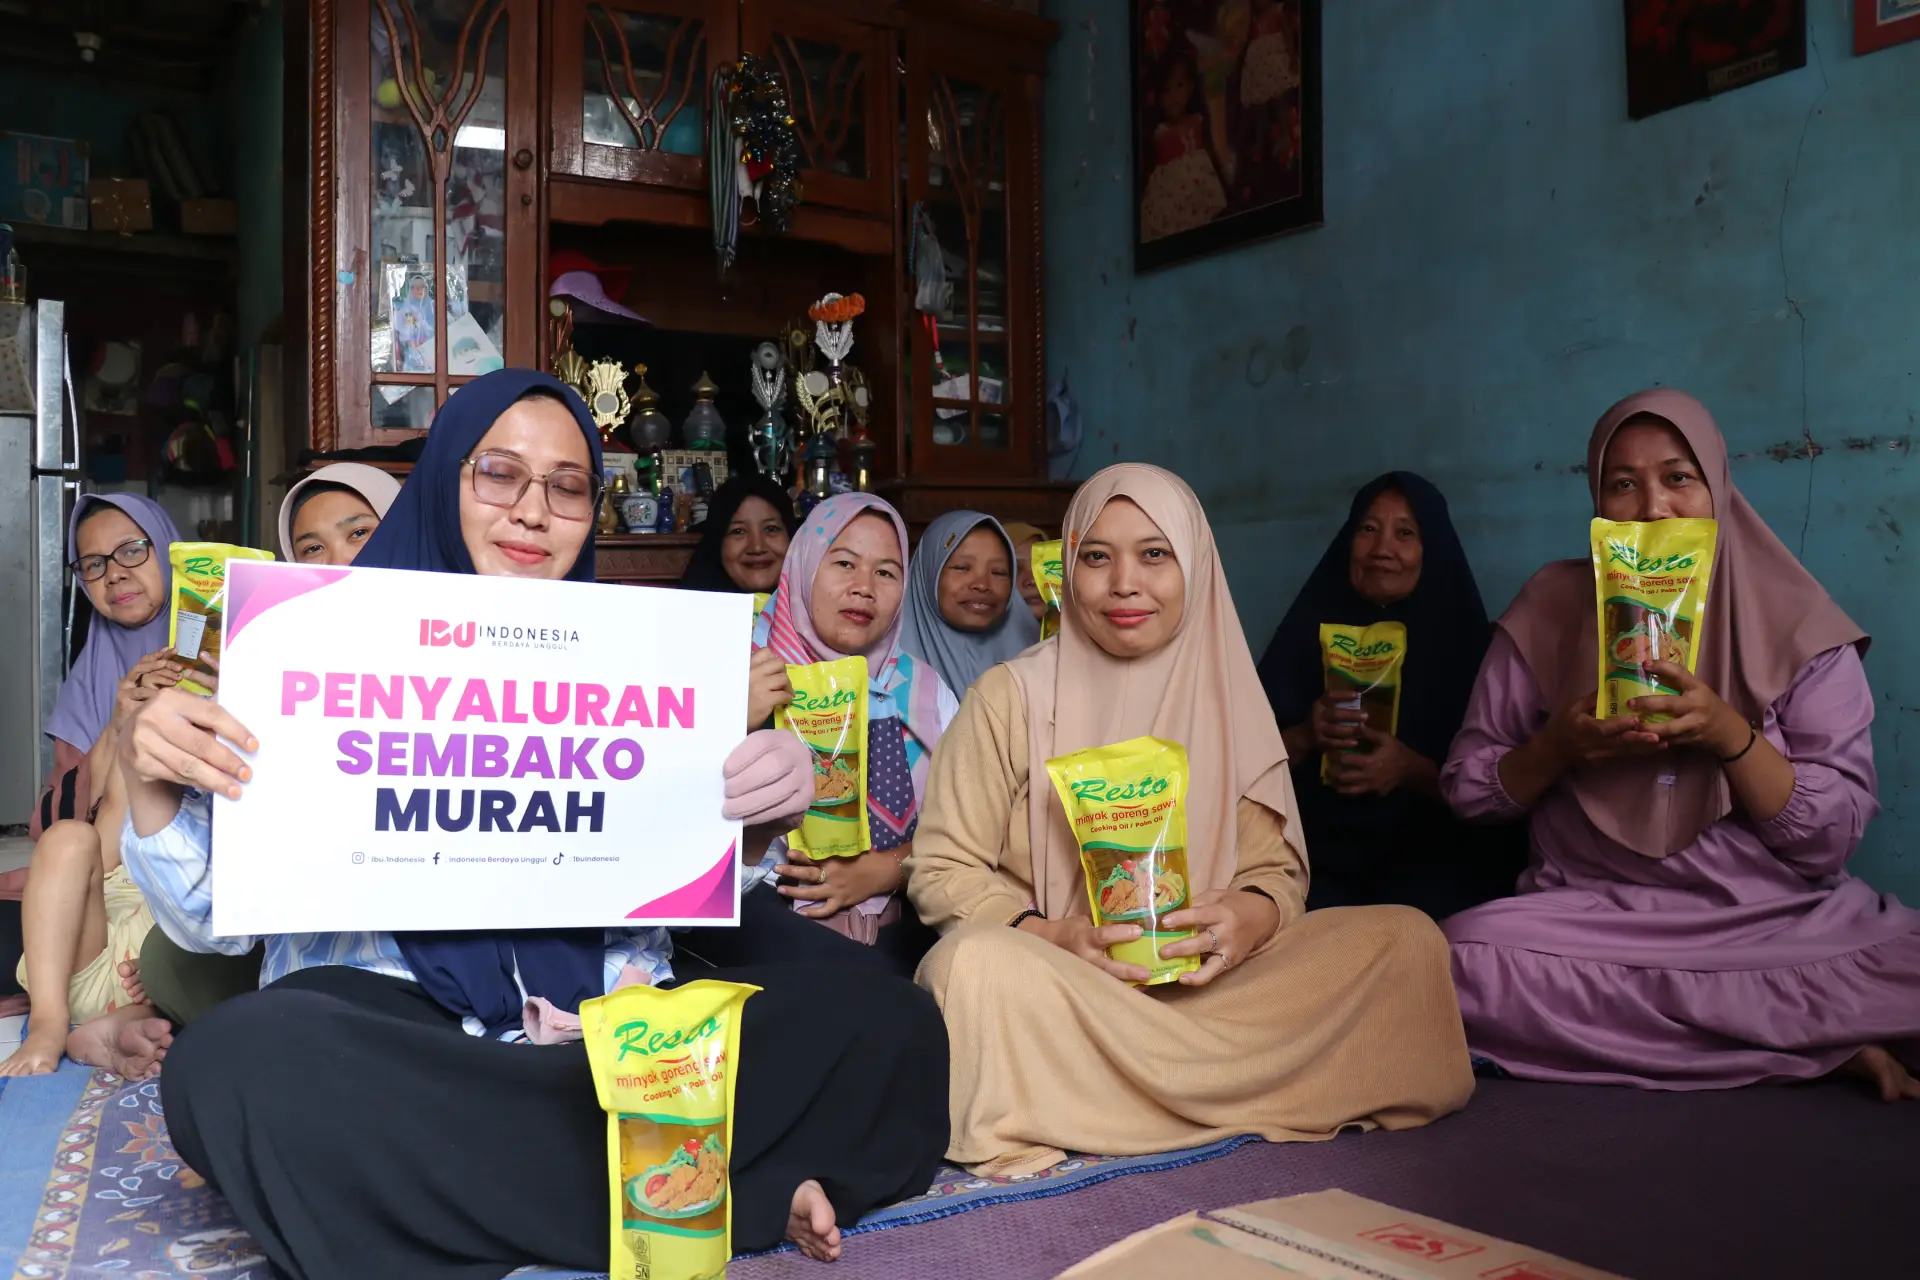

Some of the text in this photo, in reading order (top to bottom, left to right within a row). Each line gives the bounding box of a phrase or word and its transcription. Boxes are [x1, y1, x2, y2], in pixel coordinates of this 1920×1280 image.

[1609, 545, 1696, 572] Resto
[1640, 577, 1674, 588] goreng
[420, 619, 580, 648] IBU INDONESIA
[492, 640, 531, 649] BERDAYA
[1330, 633, 1394, 657] Resto
[281, 670, 695, 729] PENYALURAN
[792, 689, 857, 711] Resto
[812, 715, 841, 728] goreng
[336, 730, 645, 780] SEMBAKO
[1071, 776, 1169, 805] Resto
[374, 788, 606, 833] MURAH
[1076, 811, 1108, 826] minyak
[1112, 808, 1149, 822] goreng
[1090, 824, 1118, 833] Cooking
[1119, 822, 1129, 830] Oil
[1135, 819, 1153, 828] Palm
[1154, 815, 1163, 823] Oil
[487, 856, 520, 864] Berdaya
[520, 856, 548, 865] Unggul
[616, 1070, 658, 1089] minyak
[661, 1061, 701, 1084] goreng
[643, 1089, 672, 1102] Cooking
[711, 1071, 723, 1082] Oil
